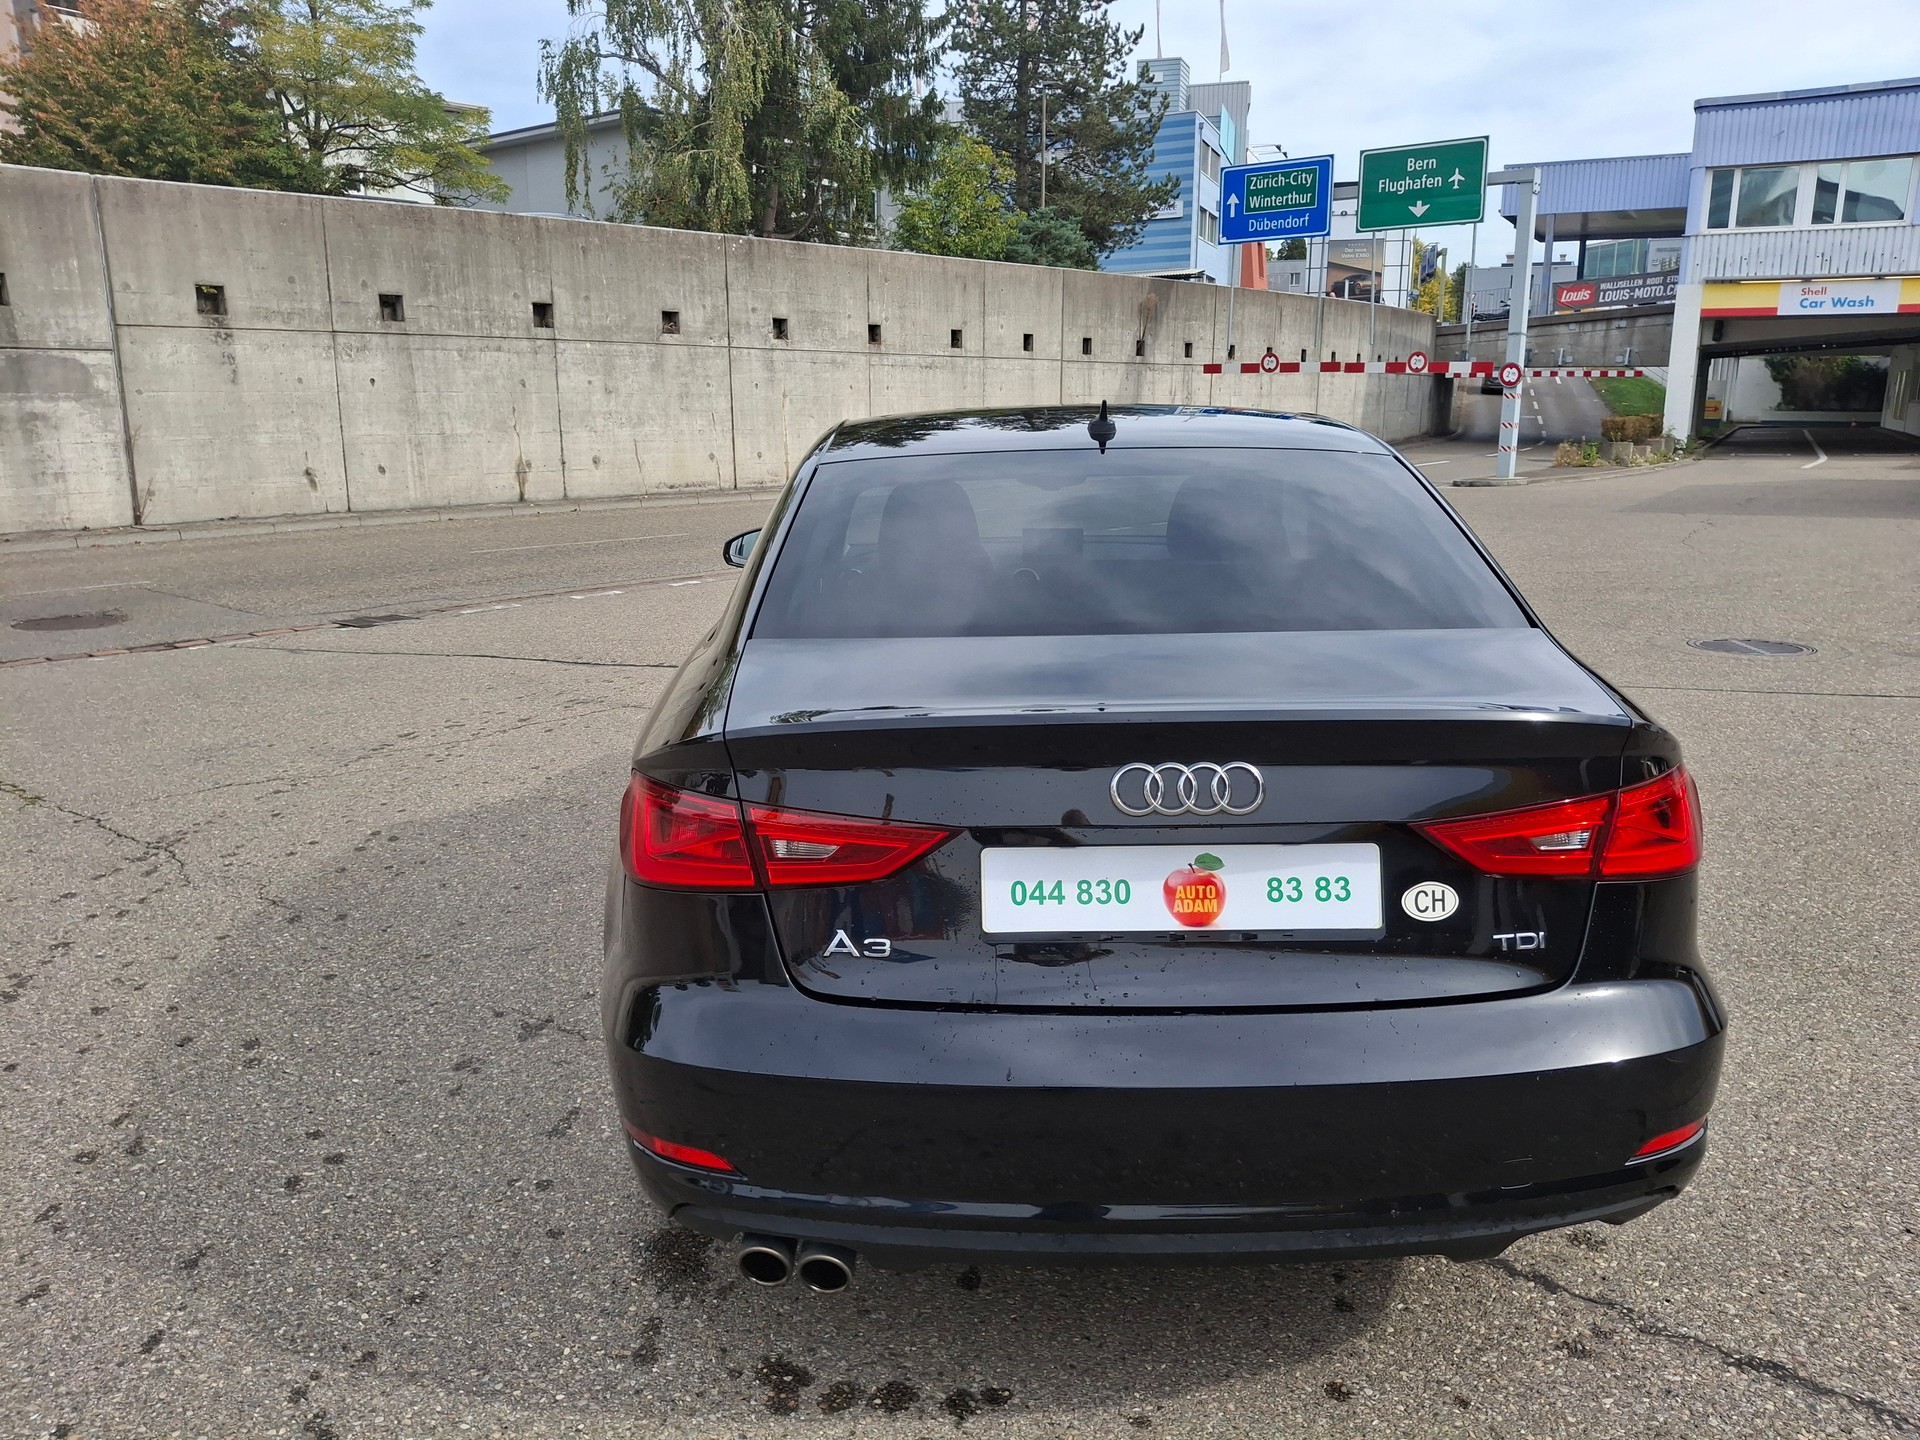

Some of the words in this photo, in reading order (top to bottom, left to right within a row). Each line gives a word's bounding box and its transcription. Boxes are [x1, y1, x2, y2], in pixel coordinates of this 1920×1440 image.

[1407, 157, 1437, 172] Bern
[1250, 171, 1313, 190] Zürich-City
[1378, 174, 1442, 195] Flughafen
[1249, 191, 1313, 209] Winterthur
[1248, 212, 1310, 232] Dübendorf
[1600, 279, 1645, 290] WALLISELLEN
[1800, 286, 1828, 296] Shell
[1561, 289, 1591, 303] Louis
[1799, 297, 1826, 309] Car
[1831, 295, 1875, 308] Wash
[1010, 879, 1065, 906] 044
[1076, 878, 1131, 905] 830
[1175, 885, 1216, 899] AUTO
[1266, 876, 1303, 903] 83
[1314, 876, 1351, 902] 83
[1173, 899, 1218, 913] ADAM
[1414, 889, 1446, 913] CH
[822, 929, 892, 958] A3
[1492, 931, 1545, 951] TDI
